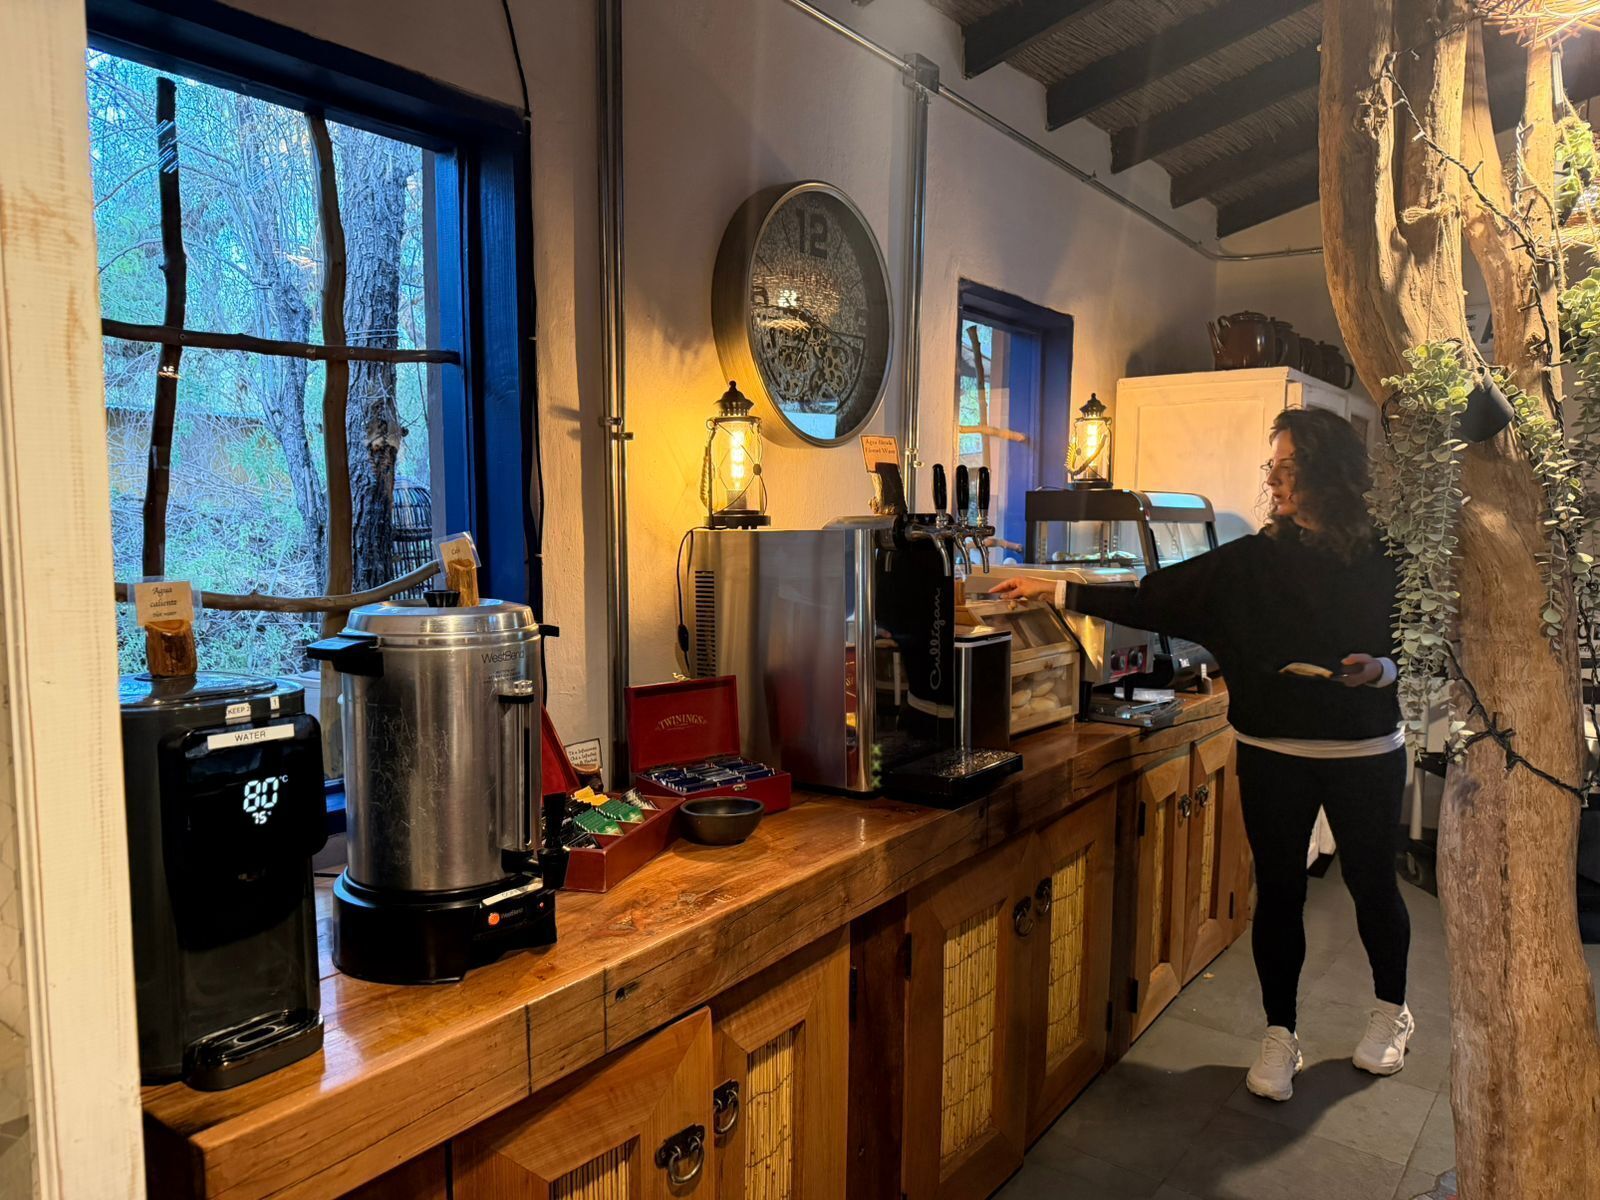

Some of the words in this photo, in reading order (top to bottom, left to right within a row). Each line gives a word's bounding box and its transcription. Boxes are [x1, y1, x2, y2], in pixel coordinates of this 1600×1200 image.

[796, 207, 828, 260] 12
[929, 587, 945, 691] Culligan
[481, 650, 525, 664] WestBend
[227, 706, 245, 715] KEEP
[659, 713, 704, 730] TWININGS
[234, 730, 266, 742] WATER
